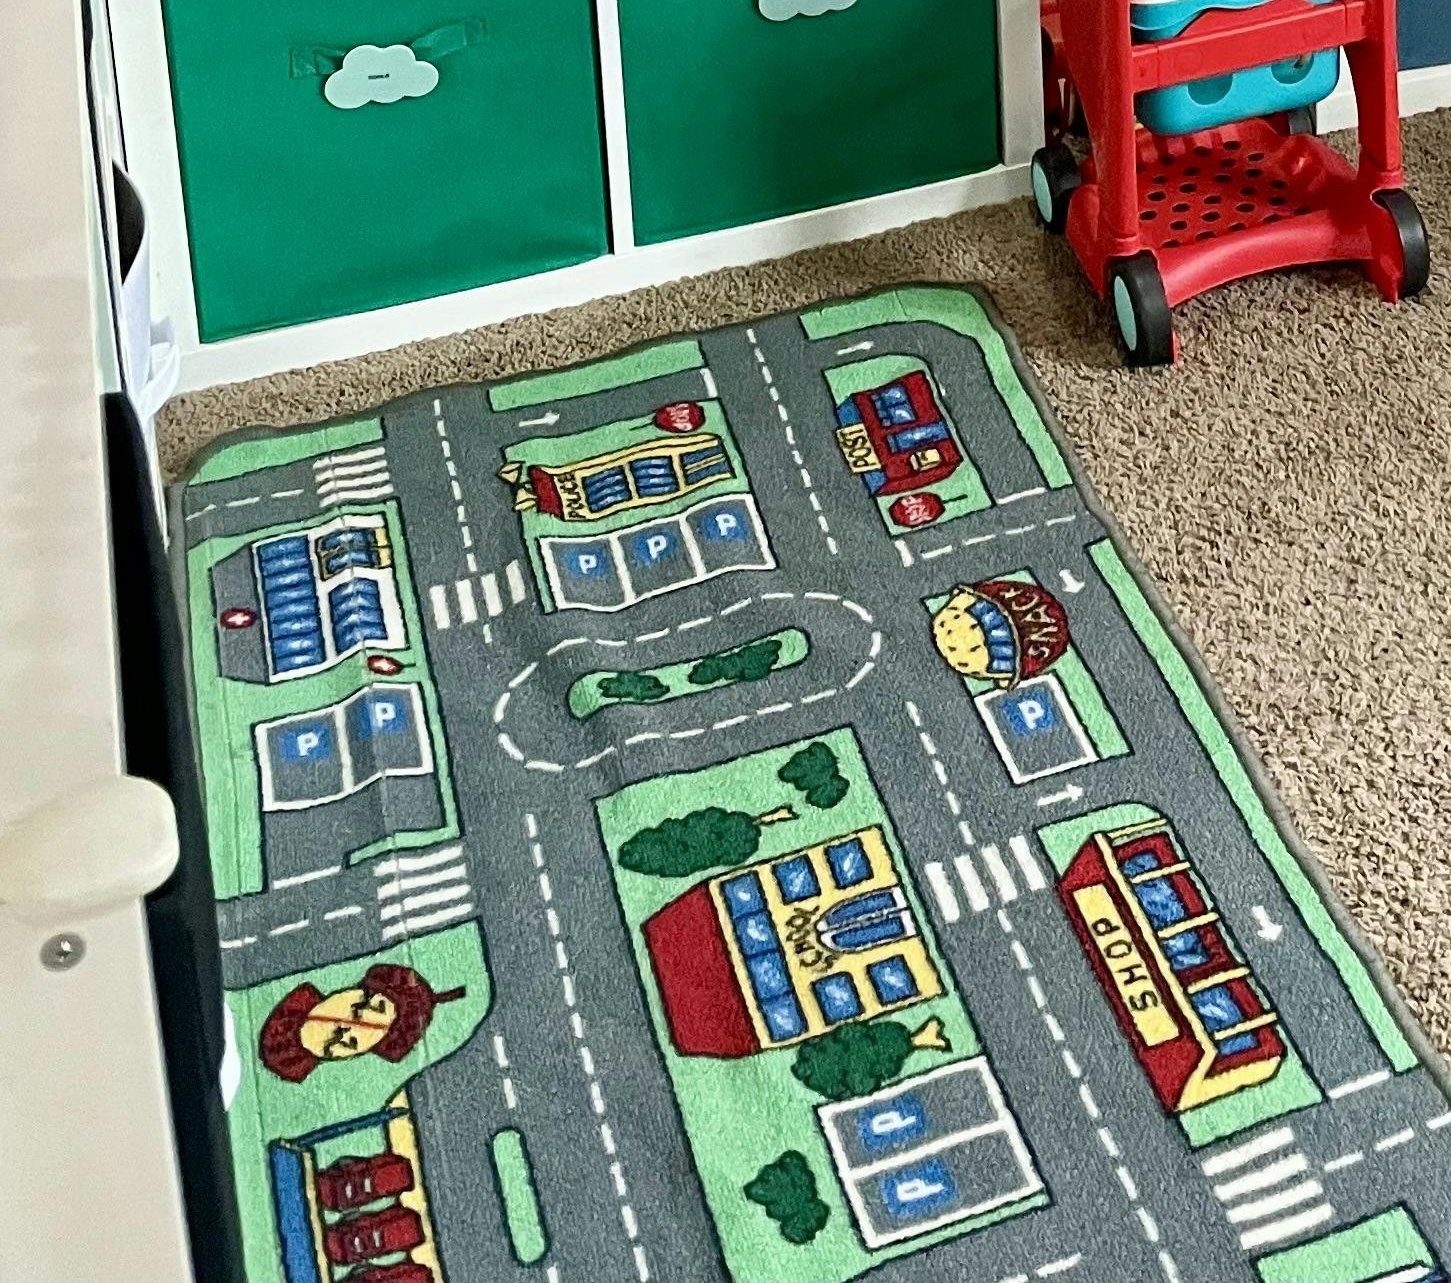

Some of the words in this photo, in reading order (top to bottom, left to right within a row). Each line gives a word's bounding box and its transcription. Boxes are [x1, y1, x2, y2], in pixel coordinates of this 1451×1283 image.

[839, 428, 876, 468] POST
[557, 473, 587, 519] POLICE
[578, 554, 598, 574] P
[646, 534, 668, 560] P
[714, 513, 737, 536] P
[999, 587, 1058, 659] SNACK
[297, 731, 319, 756] P
[374, 702, 397, 729] P
[1017, 700, 1045, 729] P
[1091, 917, 1159, 1012] SHOP
[872, 1111, 917, 1135] P
[896, 1178, 945, 1202] P
